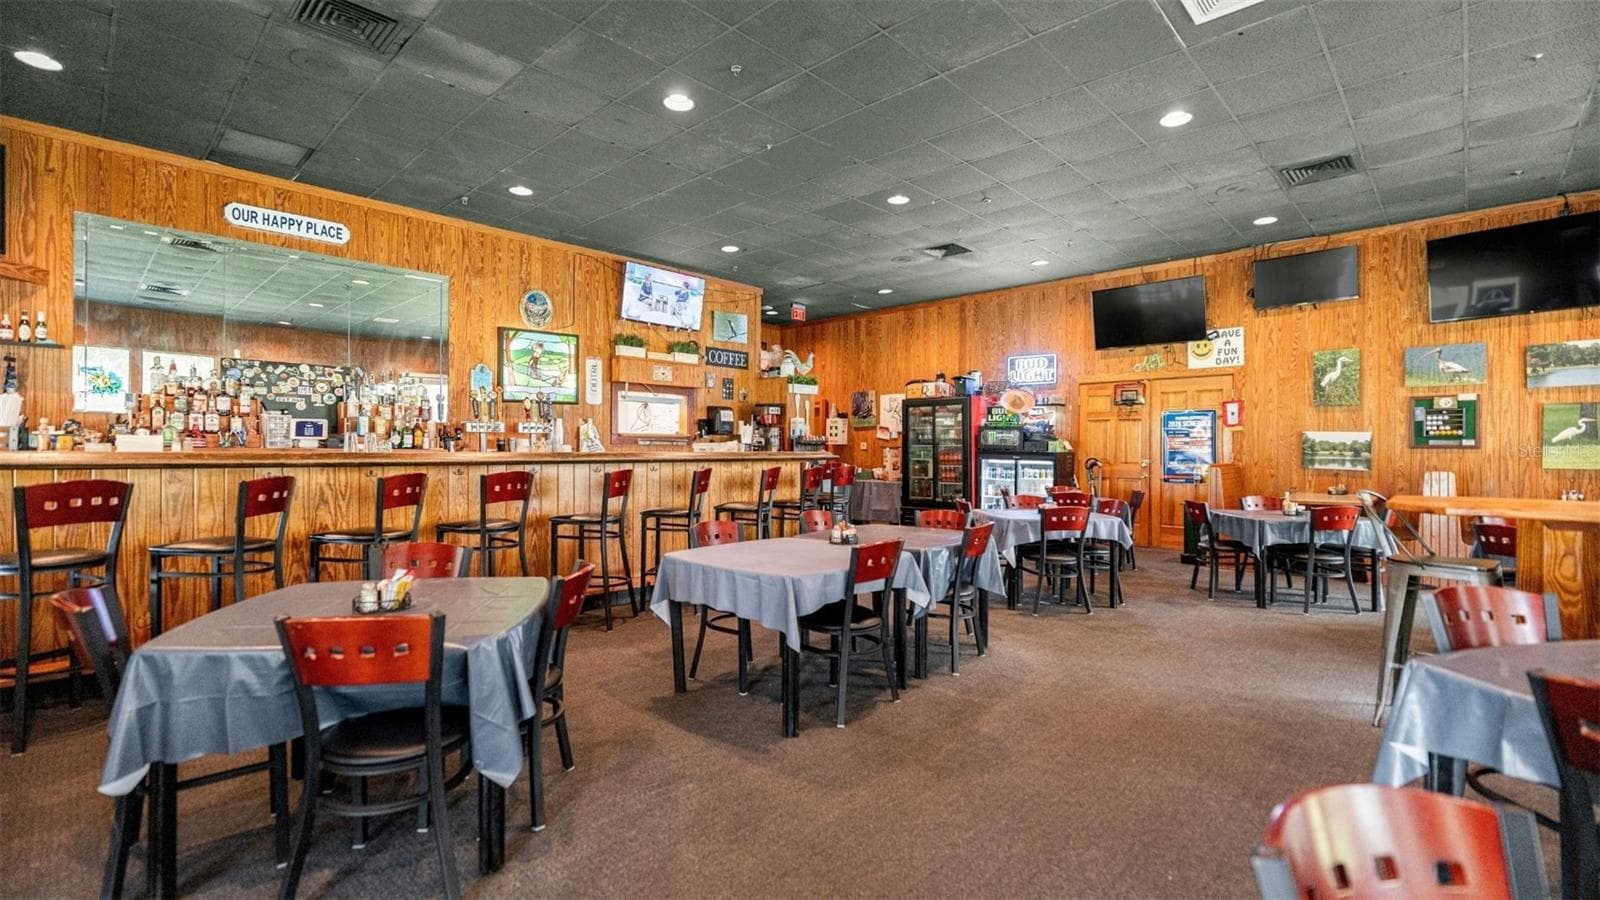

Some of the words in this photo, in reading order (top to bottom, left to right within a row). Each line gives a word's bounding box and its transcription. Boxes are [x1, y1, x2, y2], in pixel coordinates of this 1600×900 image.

[231, 207, 259, 225] OUR
[262, 212, 304, 232] HAPPY
[306, 221, 344, 240] PLACE
[1224, 339, 1231, 347] A
[1217, 347, 1238, 356] FUN
[708, 349, 747, 367] COFFEE
[1015, 357, 1048, 370] BUD
[1215, 356, 1240, 366] DAY!
